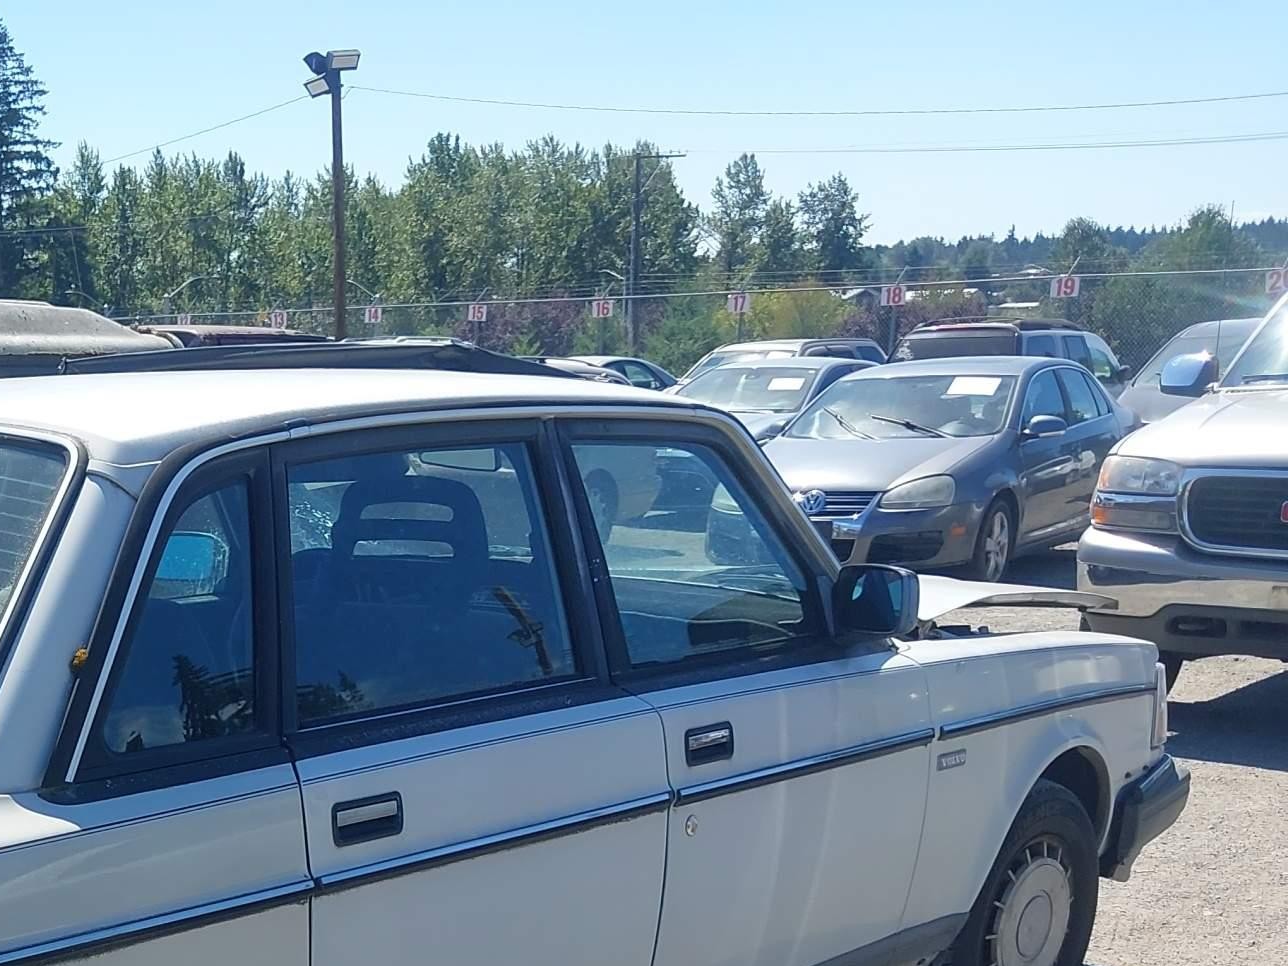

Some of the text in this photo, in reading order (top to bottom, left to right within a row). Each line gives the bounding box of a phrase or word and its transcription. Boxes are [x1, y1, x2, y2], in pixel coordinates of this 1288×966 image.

[1055, 277, 1075, 296] 19
[733, 295, 746, 312] 17
[886, 287, 902, 305] 18
[367, 308, 379, 322] 14
[471, 306, 484, 320] 15
[596, 301, 610, 316] 16
[273, 311, 285, 328] 13
